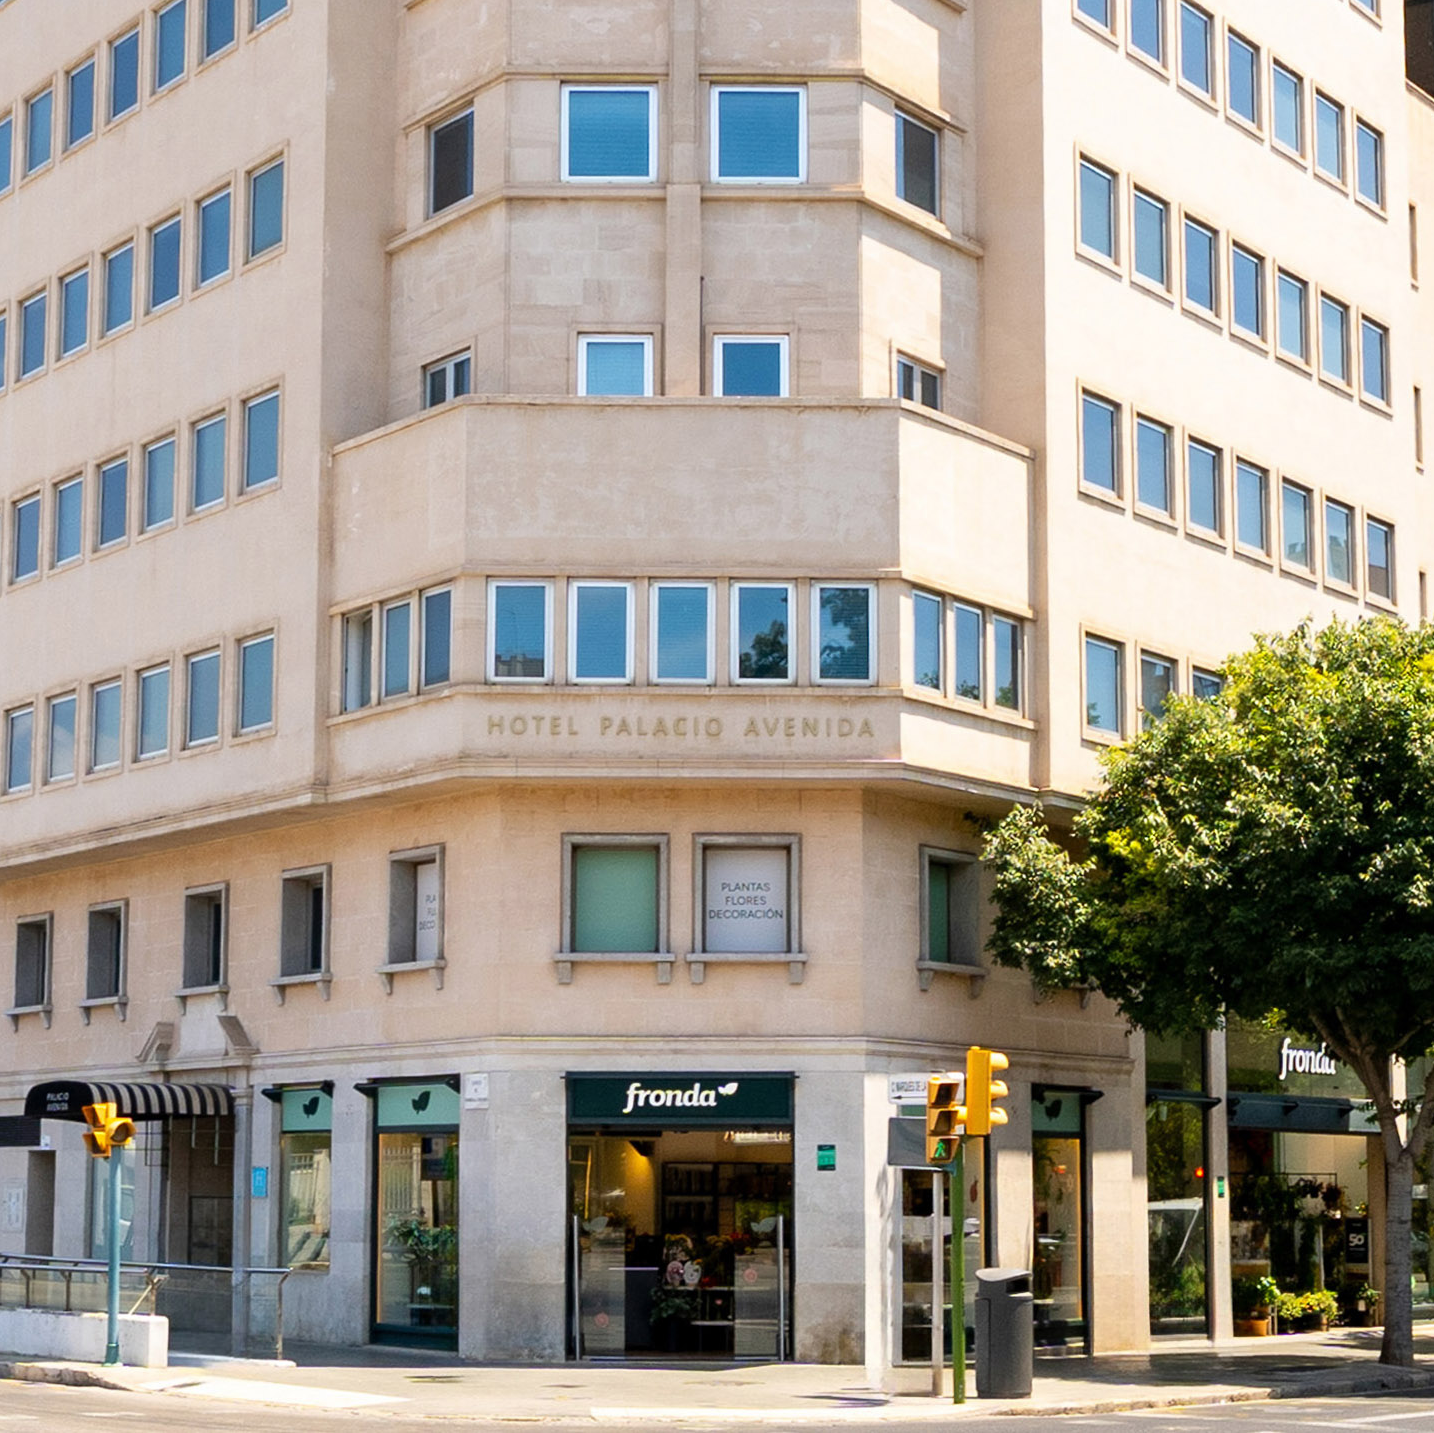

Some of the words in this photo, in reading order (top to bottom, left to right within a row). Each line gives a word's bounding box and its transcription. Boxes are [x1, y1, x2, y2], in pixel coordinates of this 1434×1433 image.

[486, 715, 579, 736] HOTEL
[600, 716, 724, 737] PALACIO
[743, 717, 875, 738] AVENIDA
[720, 881, 772, 893] PLANTAS
[725, 895, 768, 906] FLORES
[708, 907, 784, 920] DECORACIÓN
[1279, 1037, 1337, 1080] fronda
[622, 1082, 718, 1114] fronda
